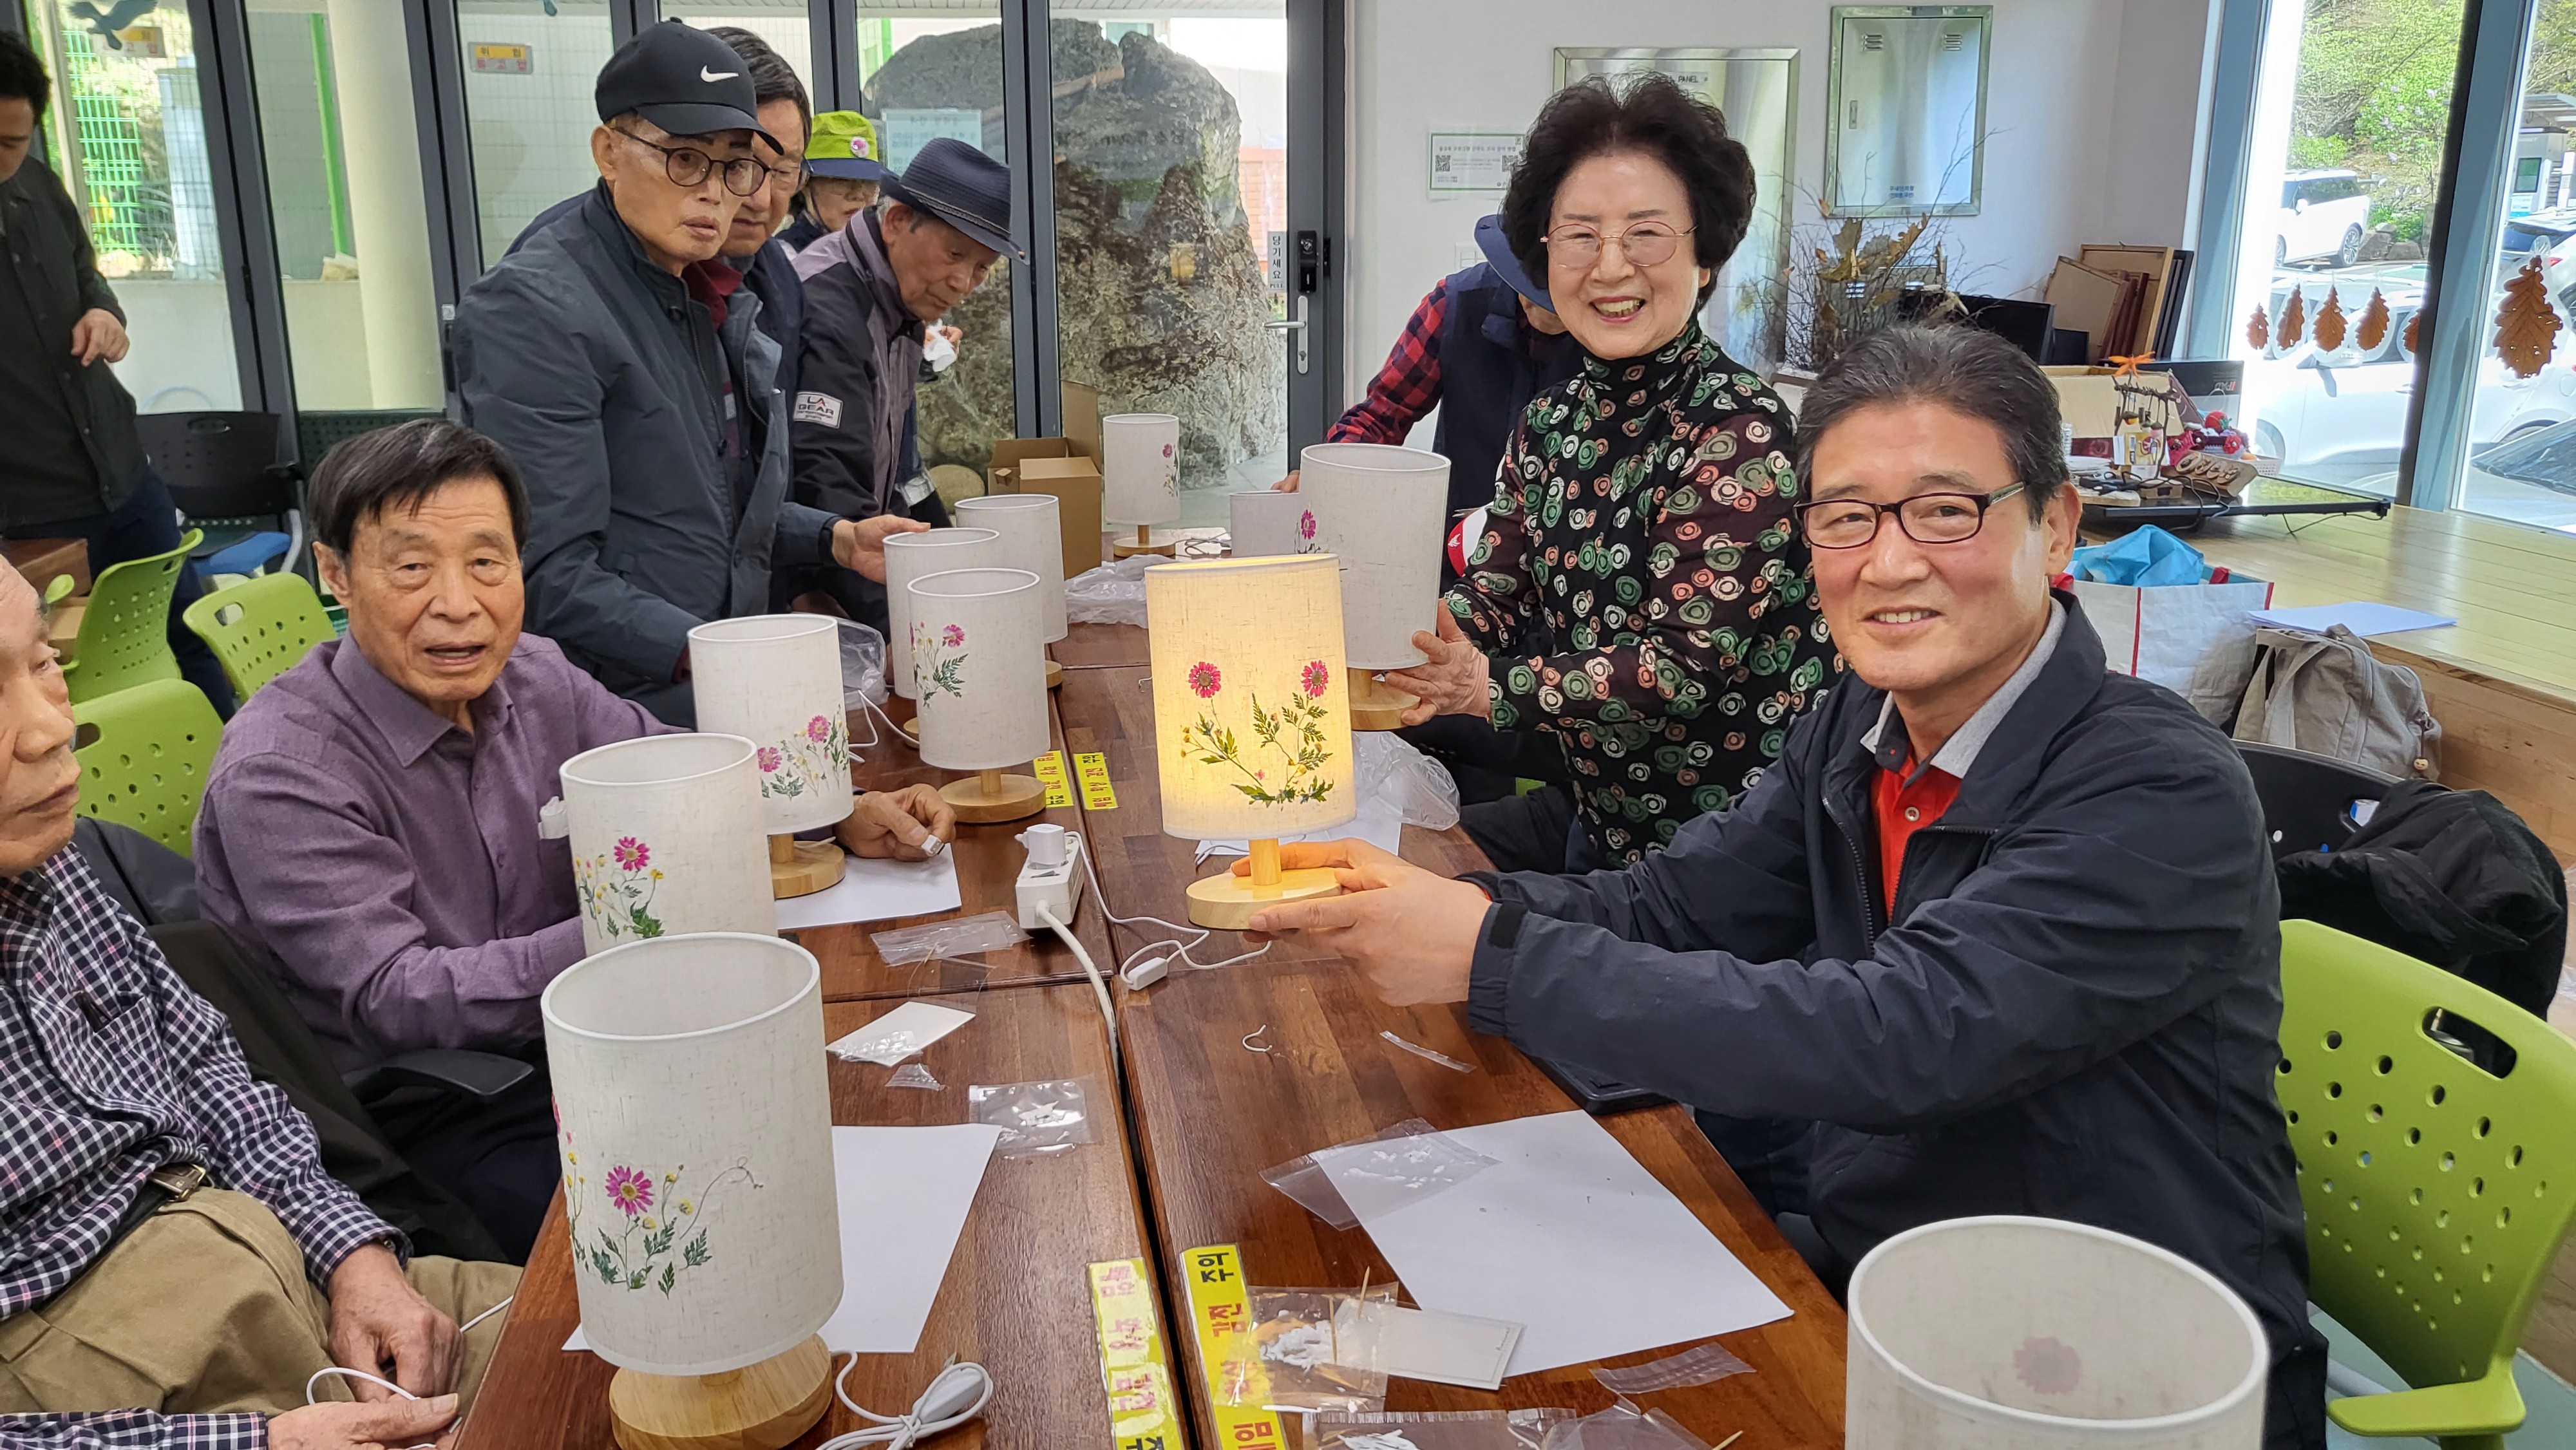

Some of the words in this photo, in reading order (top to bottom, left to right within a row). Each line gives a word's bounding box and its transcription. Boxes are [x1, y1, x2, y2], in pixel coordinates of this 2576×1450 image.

[1272, 235, 1282, 279] 당기세요
[807, 396, 826, 407] LA
[799, 404, 835, 416] GEAR
[1082, 754, 1101, 764] 주의
[1085, 767, 1104, 778] 감전
[1045, 795, 1065, 805] 주의
[1197, 1252, 1234, 1283] 주의
[1208, 1303, 1246, 1338] 감전
